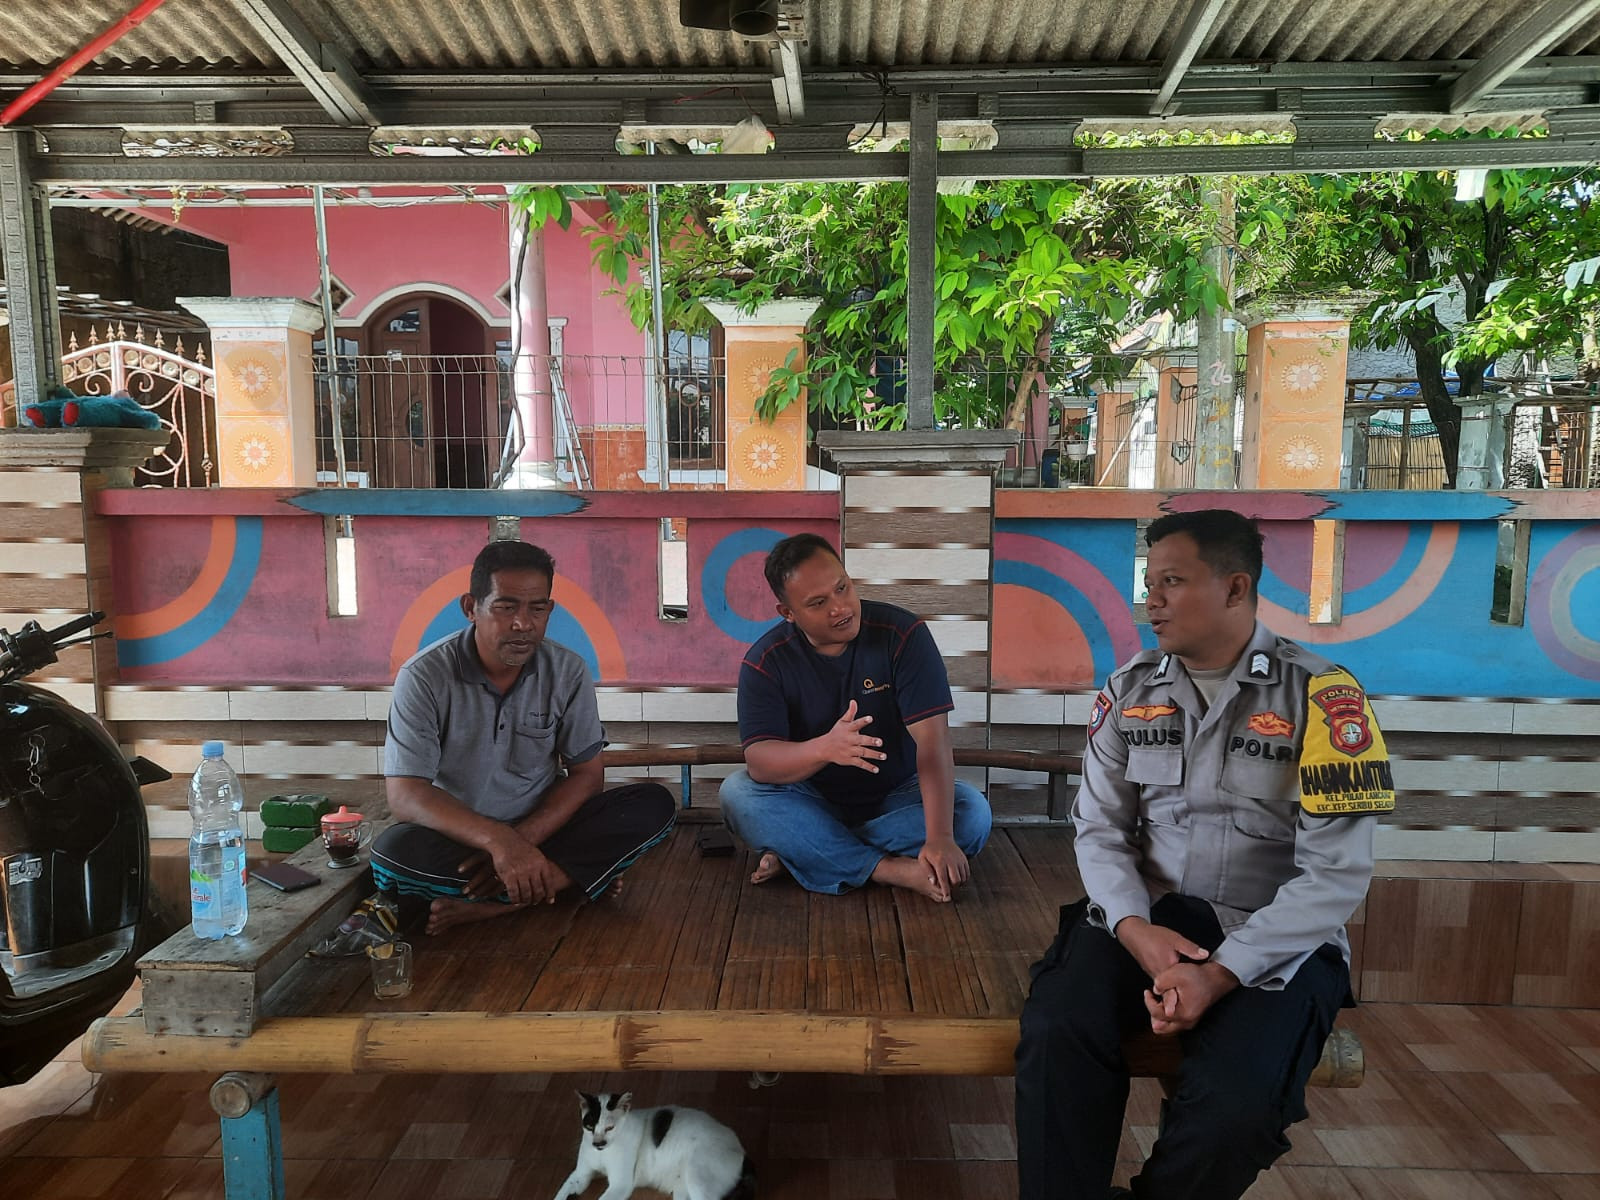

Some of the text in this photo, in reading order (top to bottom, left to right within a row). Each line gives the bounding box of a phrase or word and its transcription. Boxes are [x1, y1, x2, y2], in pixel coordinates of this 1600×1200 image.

[1321, 689, 1360, 702] POLRES
[1122, 728, 1183, 747] TULUS
[1230, 736, 1294, 762] POLR
